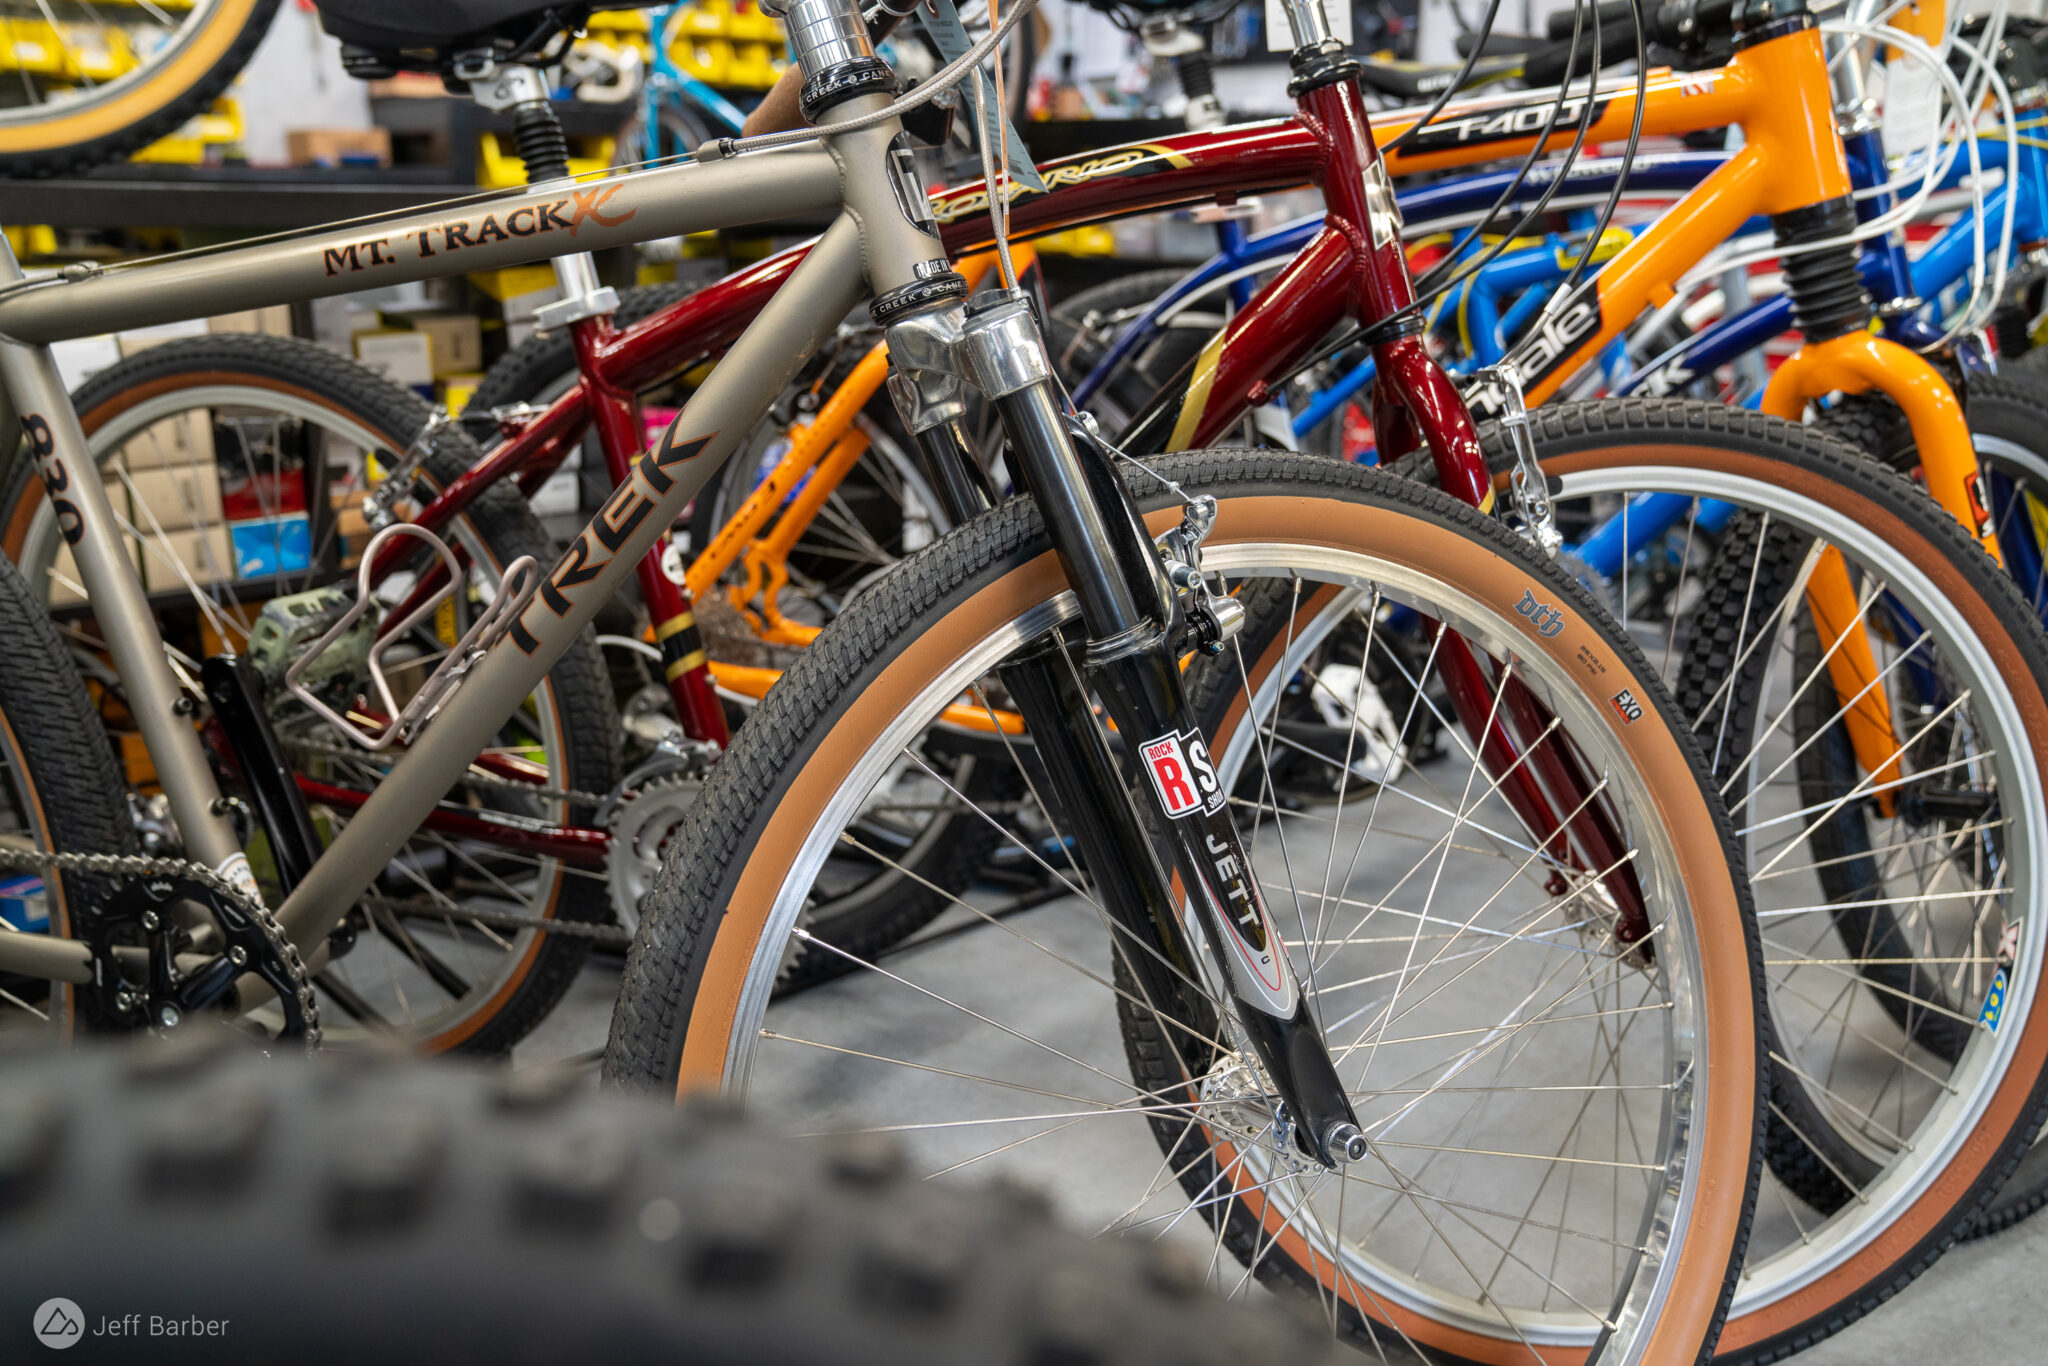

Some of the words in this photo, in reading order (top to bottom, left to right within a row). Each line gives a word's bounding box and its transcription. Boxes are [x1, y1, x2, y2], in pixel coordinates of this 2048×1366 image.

[806, 80, 843, 103] CREEK
[323, 239, 396, 276] MT.
[406, 199, 575, 257] TRACK
[879, 294, 917, 313] CREEK
[937, 280, 963, 292] CANE
[20, 413, 86, 546] 830
[495, 402, 720, 658] TREK
[1615, 688, 1643, 721] EXO
[1147, 741, 1174, 760] ROCK
[1205, 834, 1260, 926] JETT
